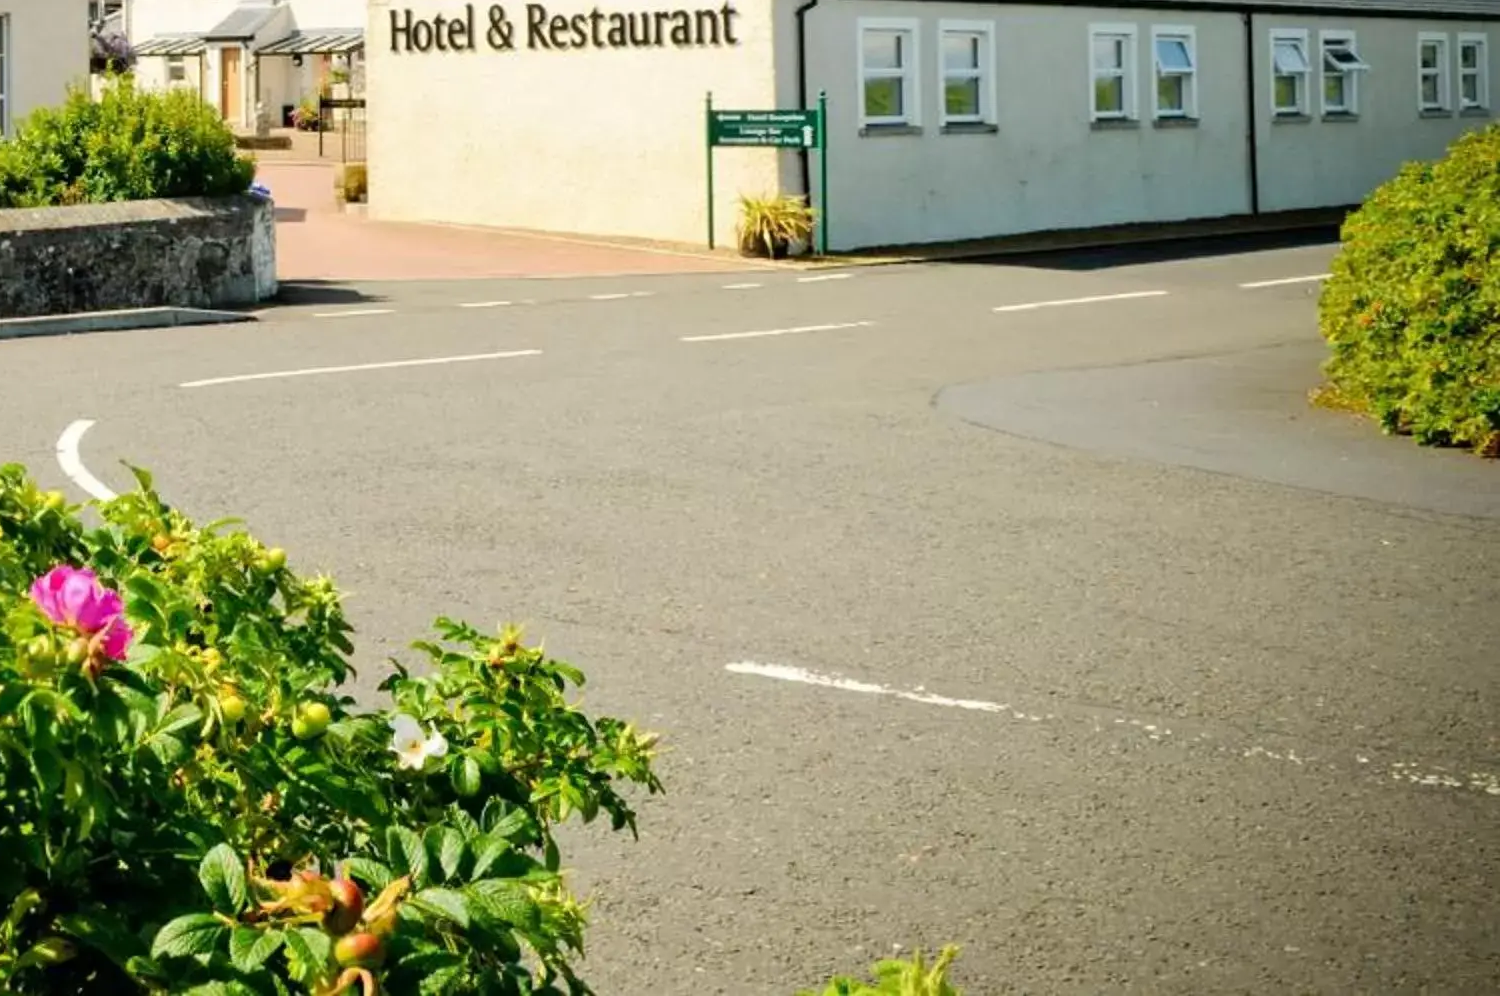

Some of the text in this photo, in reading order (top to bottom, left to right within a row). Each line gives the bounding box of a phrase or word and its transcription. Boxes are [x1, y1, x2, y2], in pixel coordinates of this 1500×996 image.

[389, 1, 739, 53] Hotel & Restaurant
